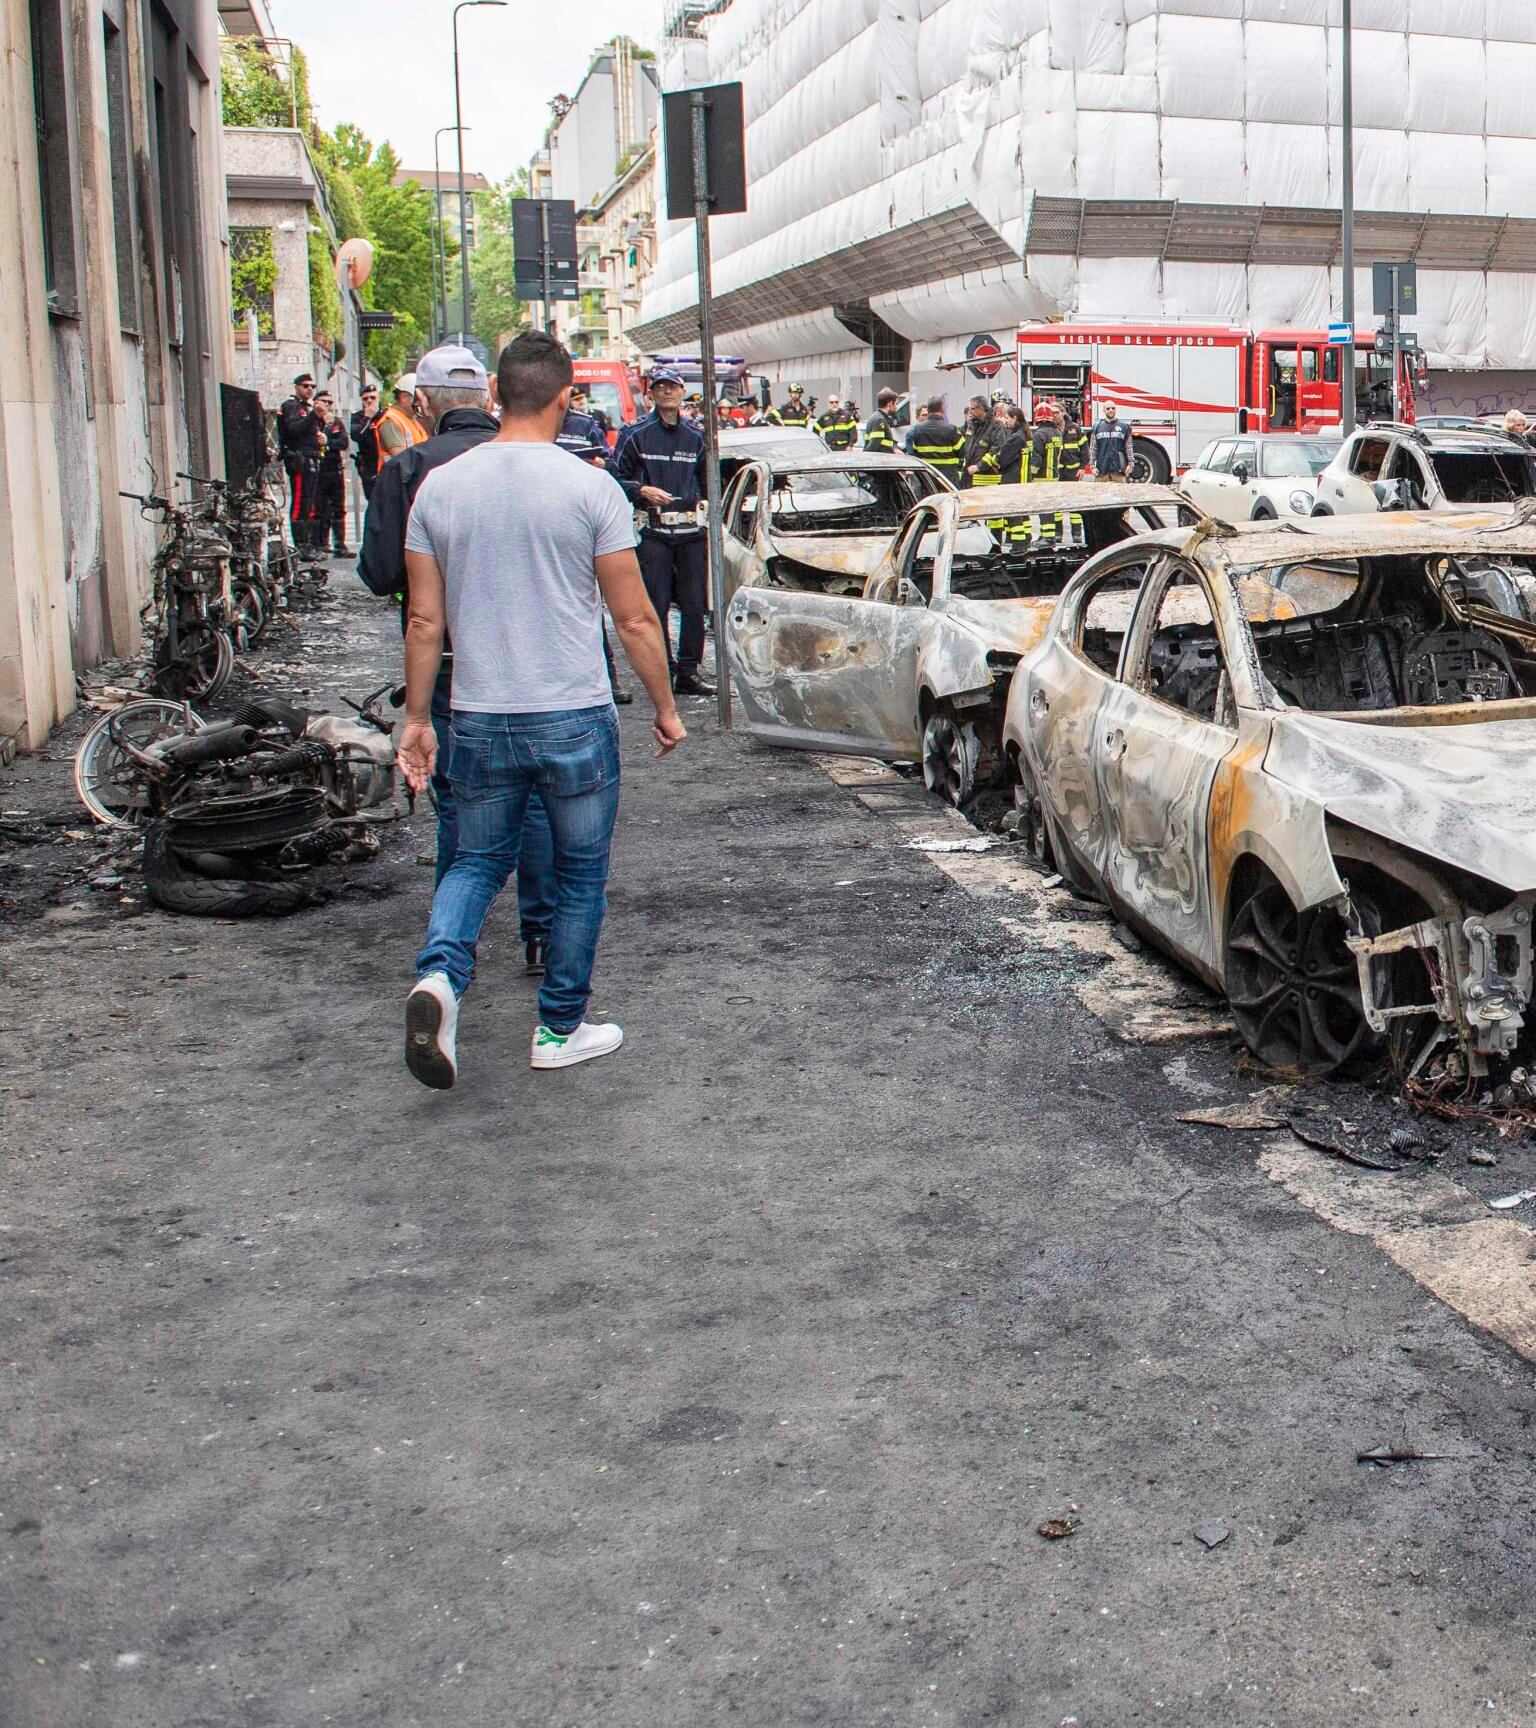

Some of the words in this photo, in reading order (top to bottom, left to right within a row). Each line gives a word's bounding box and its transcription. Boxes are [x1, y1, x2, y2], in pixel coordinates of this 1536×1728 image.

[1059, 335, 1111, 344] VIGILI
[1124, 335, 1153, 345] DEL
[1166, 336, 1214, 346] FUOCO
